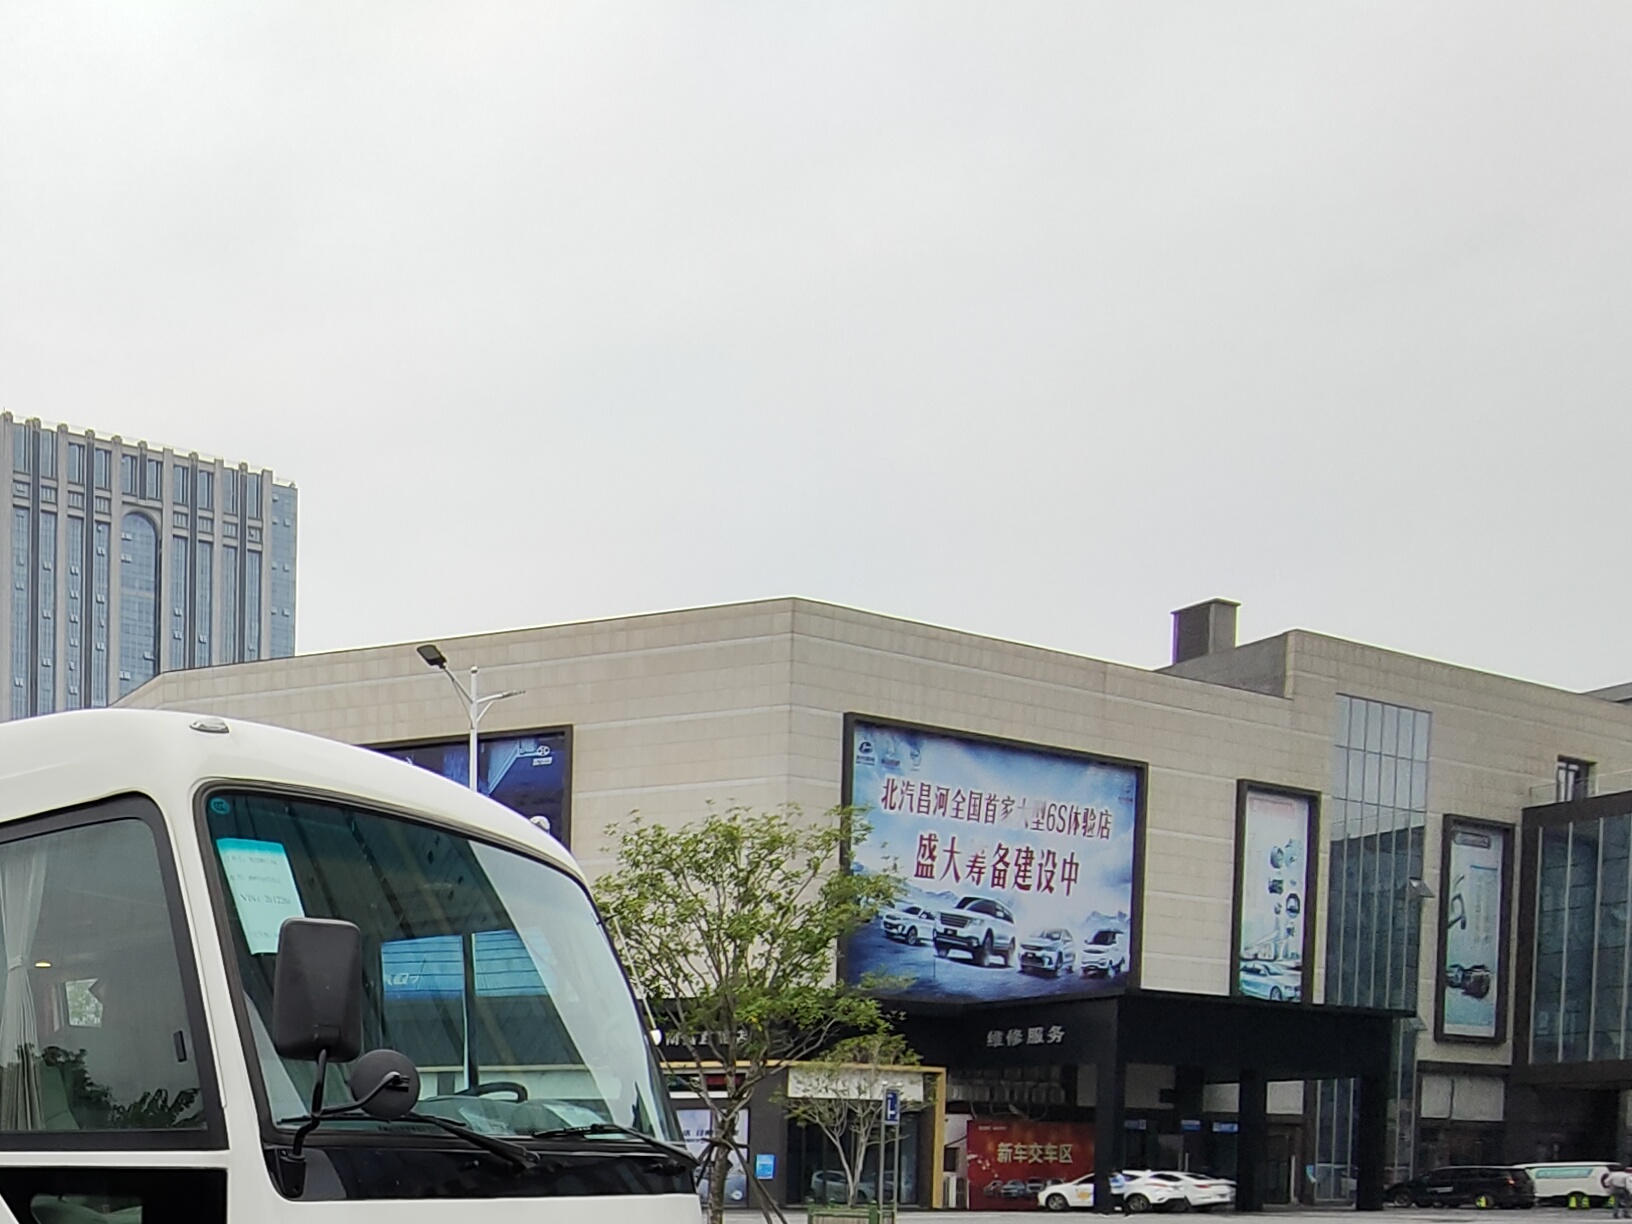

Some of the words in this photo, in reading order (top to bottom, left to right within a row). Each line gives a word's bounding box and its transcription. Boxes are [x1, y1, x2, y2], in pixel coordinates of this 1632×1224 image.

[986, 1025, 1066, 1048] 维修服务
[996, 1142, 1073, 1164] 新车交车区
